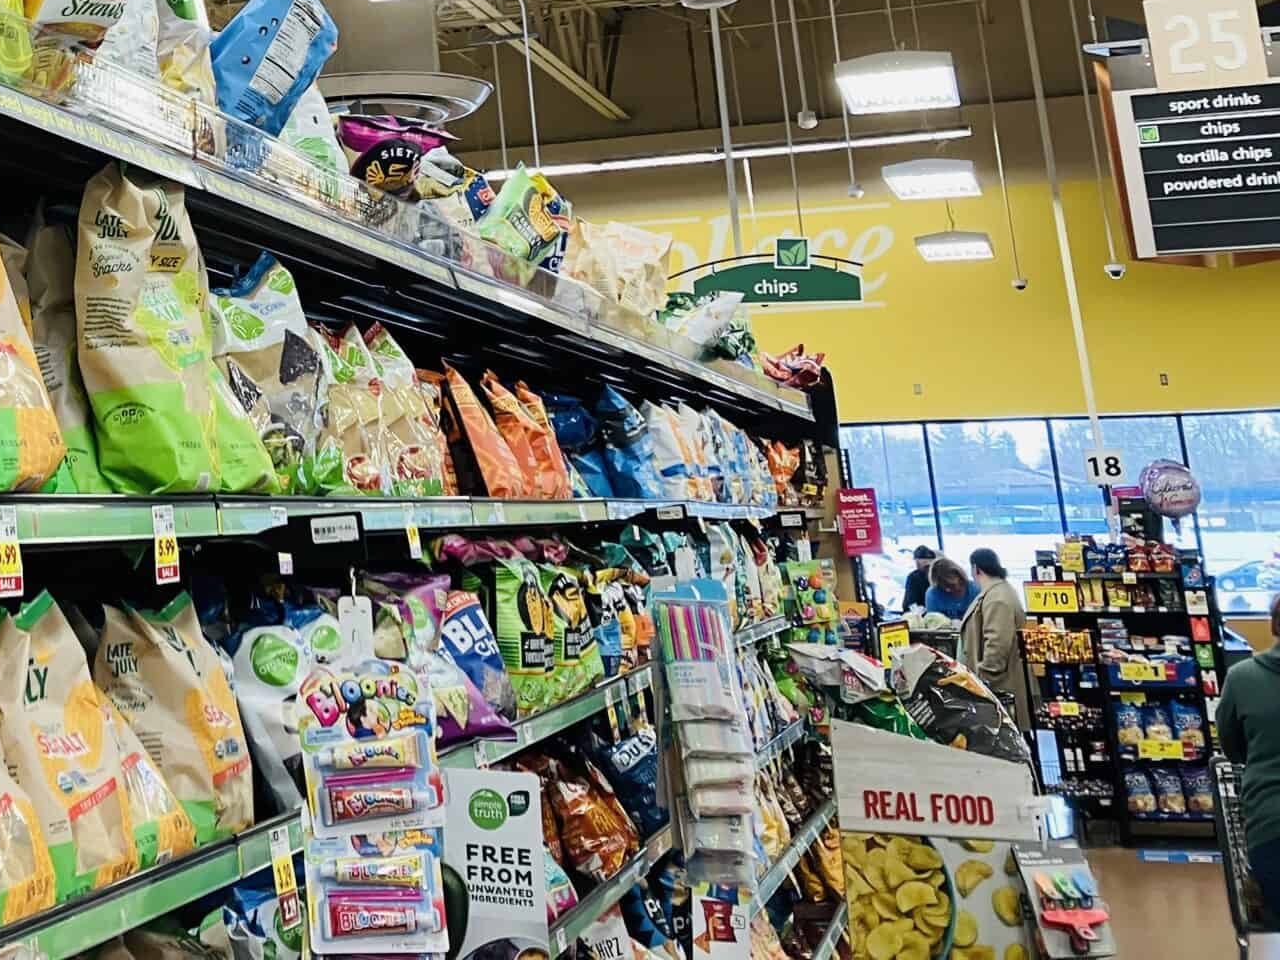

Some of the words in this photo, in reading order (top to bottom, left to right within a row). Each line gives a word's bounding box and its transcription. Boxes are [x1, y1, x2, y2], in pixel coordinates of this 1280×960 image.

[1163, 9, 1249, 75] 25
[1169, 97, 1210, 113] sport
[1212, 91, 1261, 108] drinks
[1200, 121, 1241, 137] chips
[1176, 148, 1229, 165] tortilla
[1231, 144, 1273, 161] chips
[1163, 174, 1243, 195] powdered
[92, 261, 132, 278] Snacks
[754, 280, 798, 297] chips
[1087, 456, 1122, 477] 18
[158, 538, 175, 556] 5.99
[0, 577, 17, 590] SALE
[106, 642, 134, 660] LATE
[111, 657, 140, 679] JULY
[258, 650, 297, 676] organic
[474, 807, 503, 820] truth
[863, 789, 925, 823] REAL
[930, 793, 995, 826] FOOD
[466, 843, 532, 867] FREE
[466, 865, 533, 888] FROM
[467, 884, 535, 899] UNWANTED
[470, 895, 535, 908] NGREDIENTS
